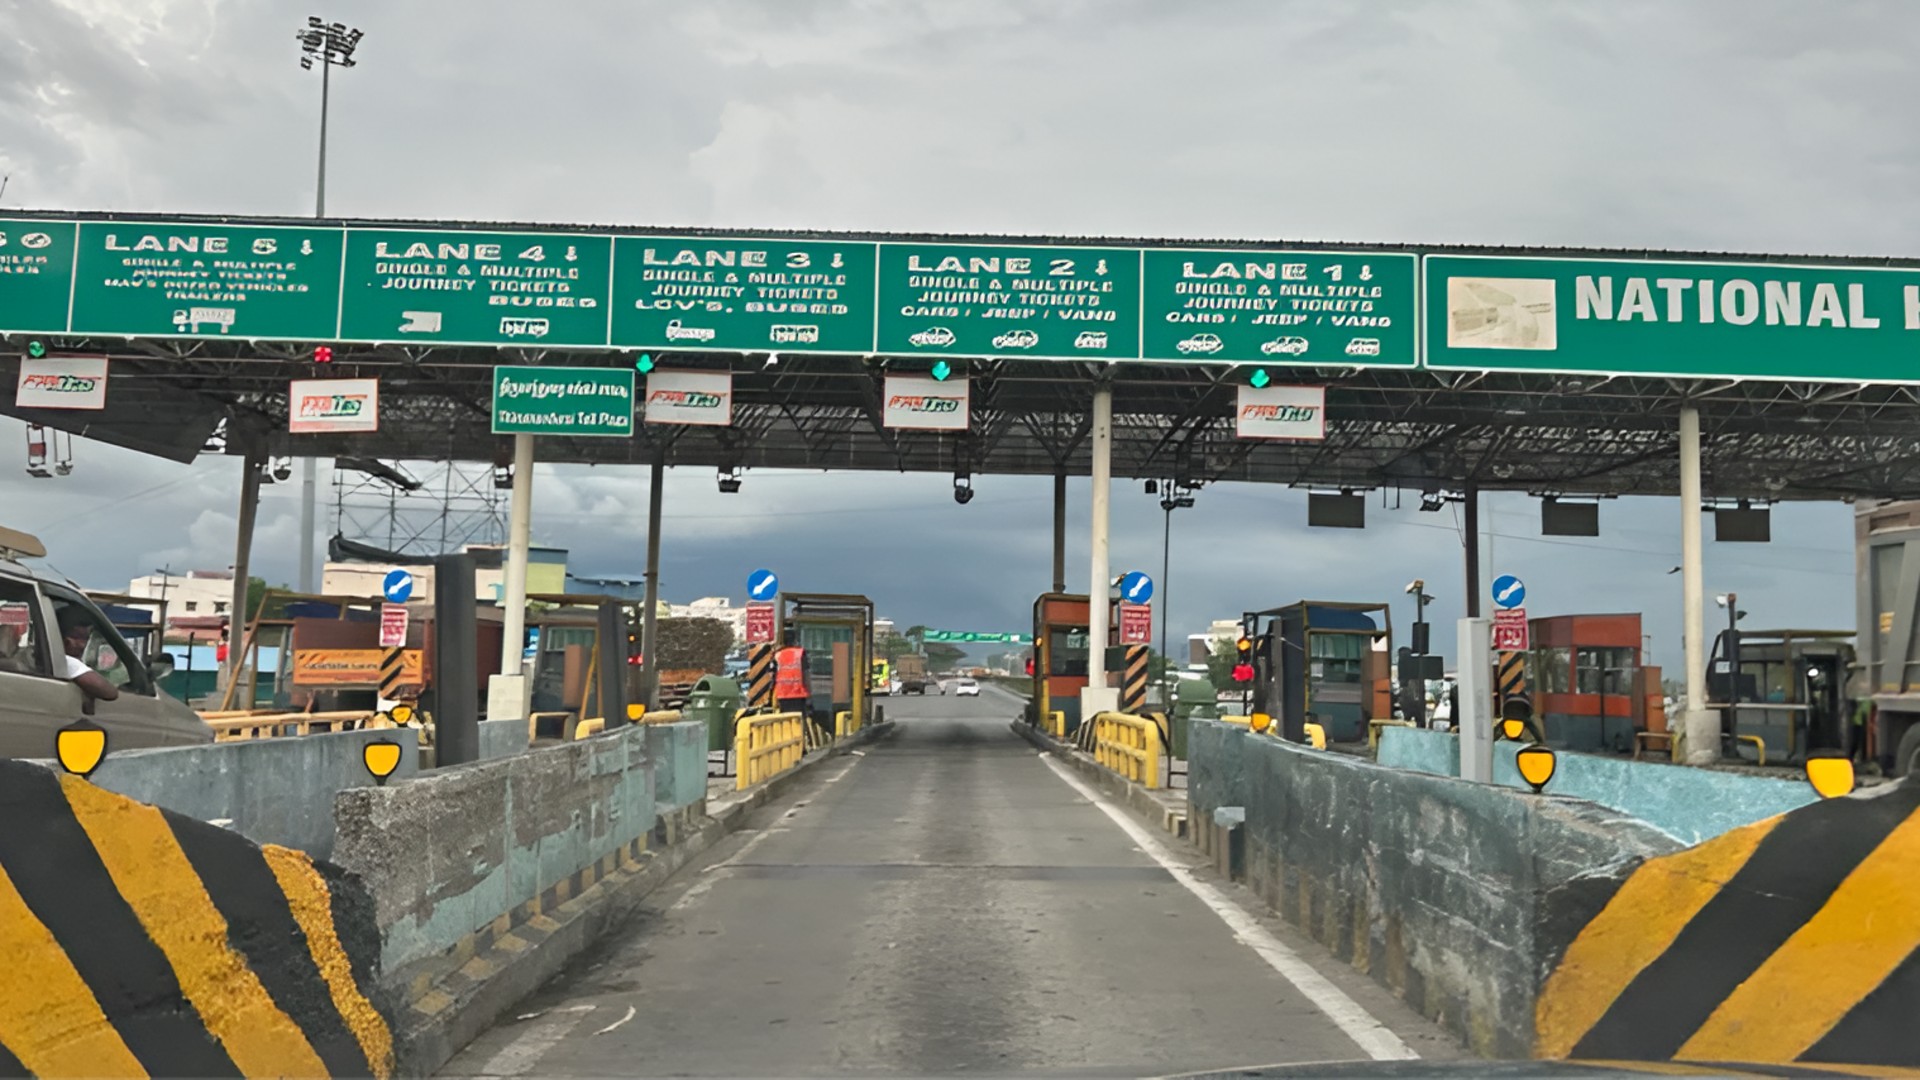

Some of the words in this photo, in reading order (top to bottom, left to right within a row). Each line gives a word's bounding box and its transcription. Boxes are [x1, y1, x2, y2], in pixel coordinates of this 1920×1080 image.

[105, 235, 228, 253] LANE
[376, 243, 501, 260] LANE
[519, 246, 545, 261] 4
[644, 249, 767, 267] LANE
[908, 256, 1031, 273] LANE
[1049, 260, 1074, 275] 2
[1183, 262, 1307, 280] LANE
[1323, 265, 1342, 281] 1
[1576, 276, 1880, 328] NATIONAL
